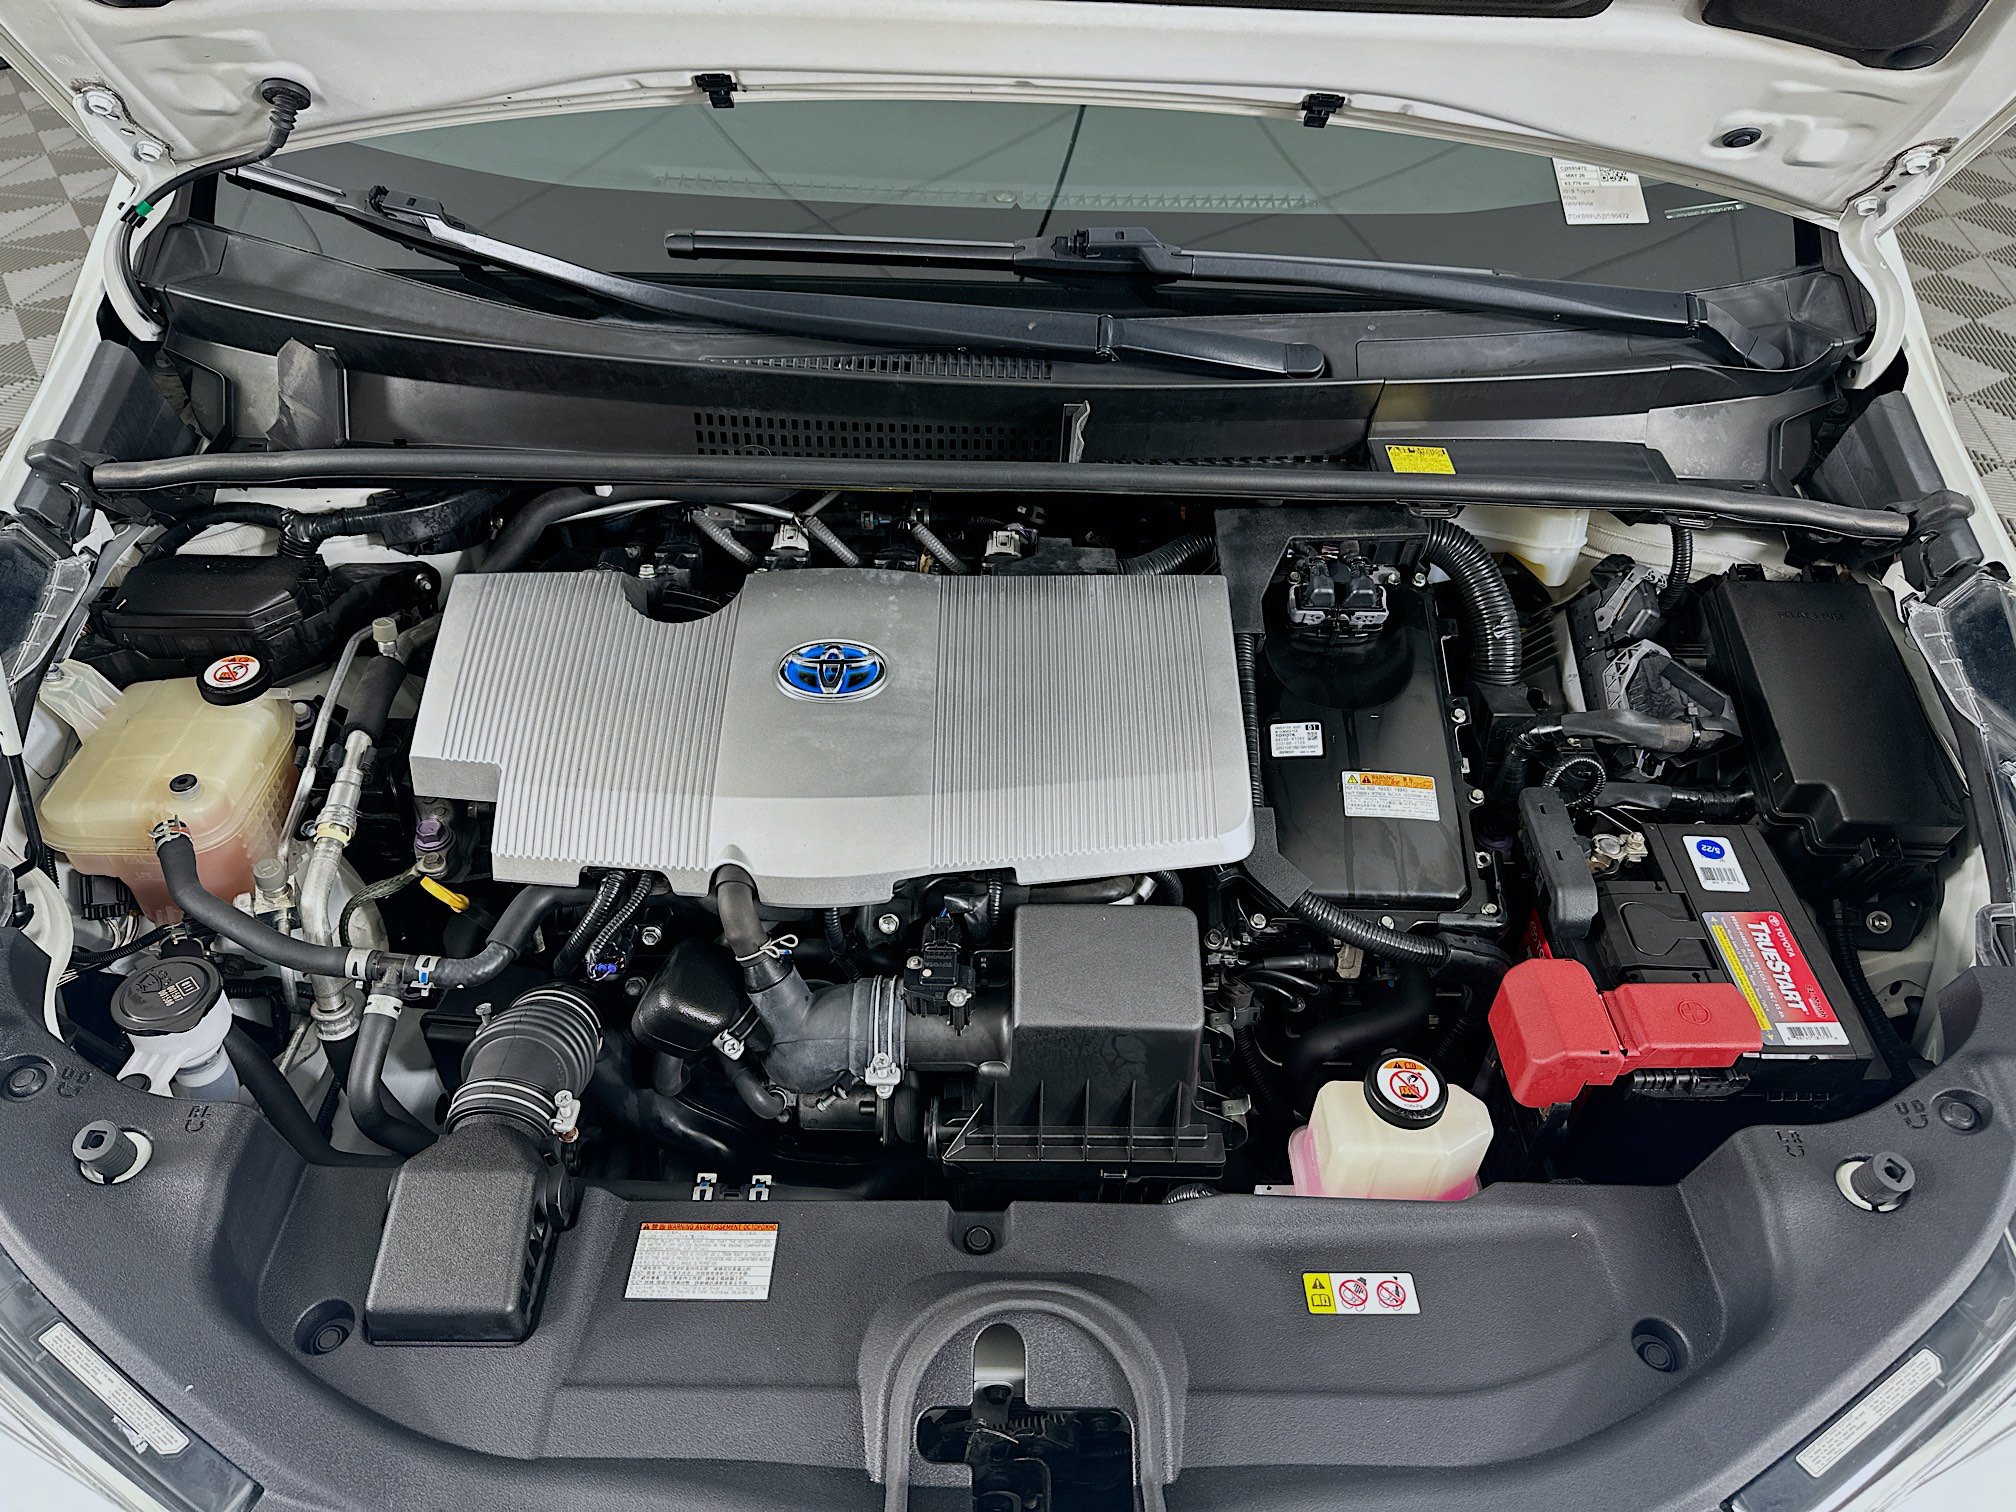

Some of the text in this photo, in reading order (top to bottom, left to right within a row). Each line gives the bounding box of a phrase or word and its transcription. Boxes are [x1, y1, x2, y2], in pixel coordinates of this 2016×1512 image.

[1700, 843, 1721, 855] 5/22
[1775, 927, 1795, 958] TOYOTA
[1758, 970, 1766, 981] CCA
